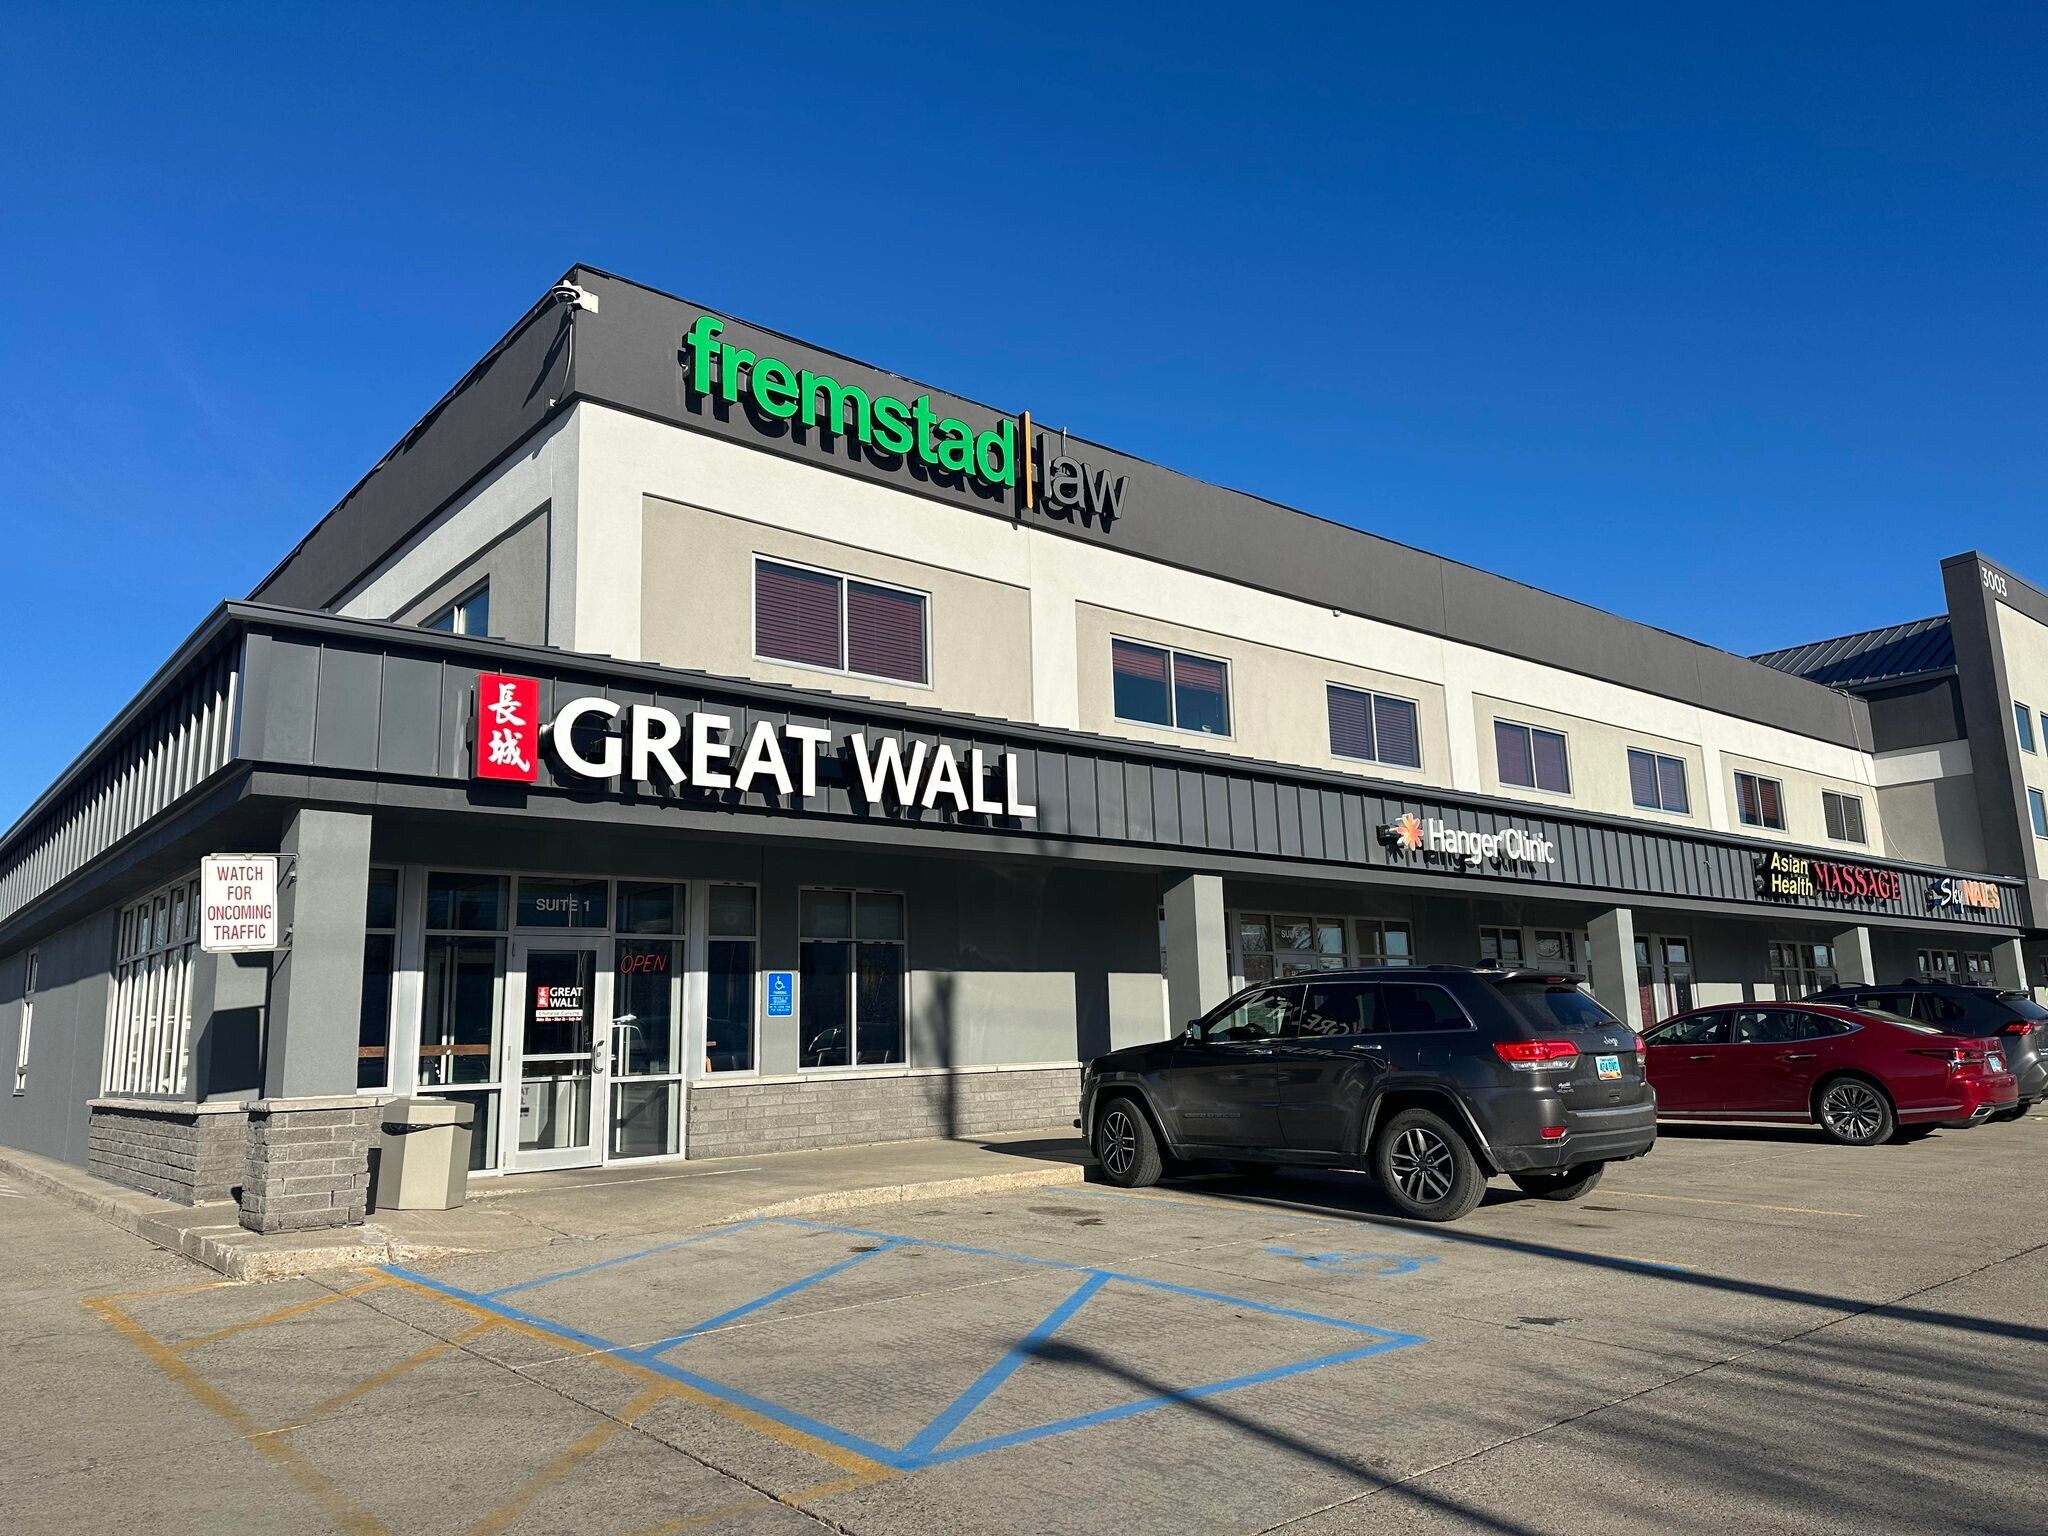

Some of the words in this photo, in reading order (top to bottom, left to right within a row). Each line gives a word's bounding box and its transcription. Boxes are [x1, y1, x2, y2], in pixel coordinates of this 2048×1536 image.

[687, 316, 1015, 488] fremstad
[1037, 432, 1130, 520] law
[1981, 566, 2007, 597] 3003
[487, 682, 531, 773] 長城
[553, 696, 832, 797] GREAT
[850, 732, 1037, 818] WALL
[1426, 817, 1503, 864] Hanger
[1503, 828, 1555, 864] Clinic
[216, 866, 263, 881] WATCH
[1770, 851, 1809, 875] Asian
[1771, 873, 1813, 896] Health
[1813, 862, 1902, 900] MASSAGE
[227, 886, 252, 900] FOR
[1941, 877, 1964, 914] Sky
[1963, 879, 2000, 909] NAILS
[207, 905, 272, 920] ONCOMING
[535, 898, 578, 912] SUITE
[583, 899, 591, 912] 1
[213, 924, 266, 940] TRAFFIC
[620, 954, 667, 974] OPEN
[550, 987, 583, 996] GREAT
[550, 998, 578, 1007] WALL
